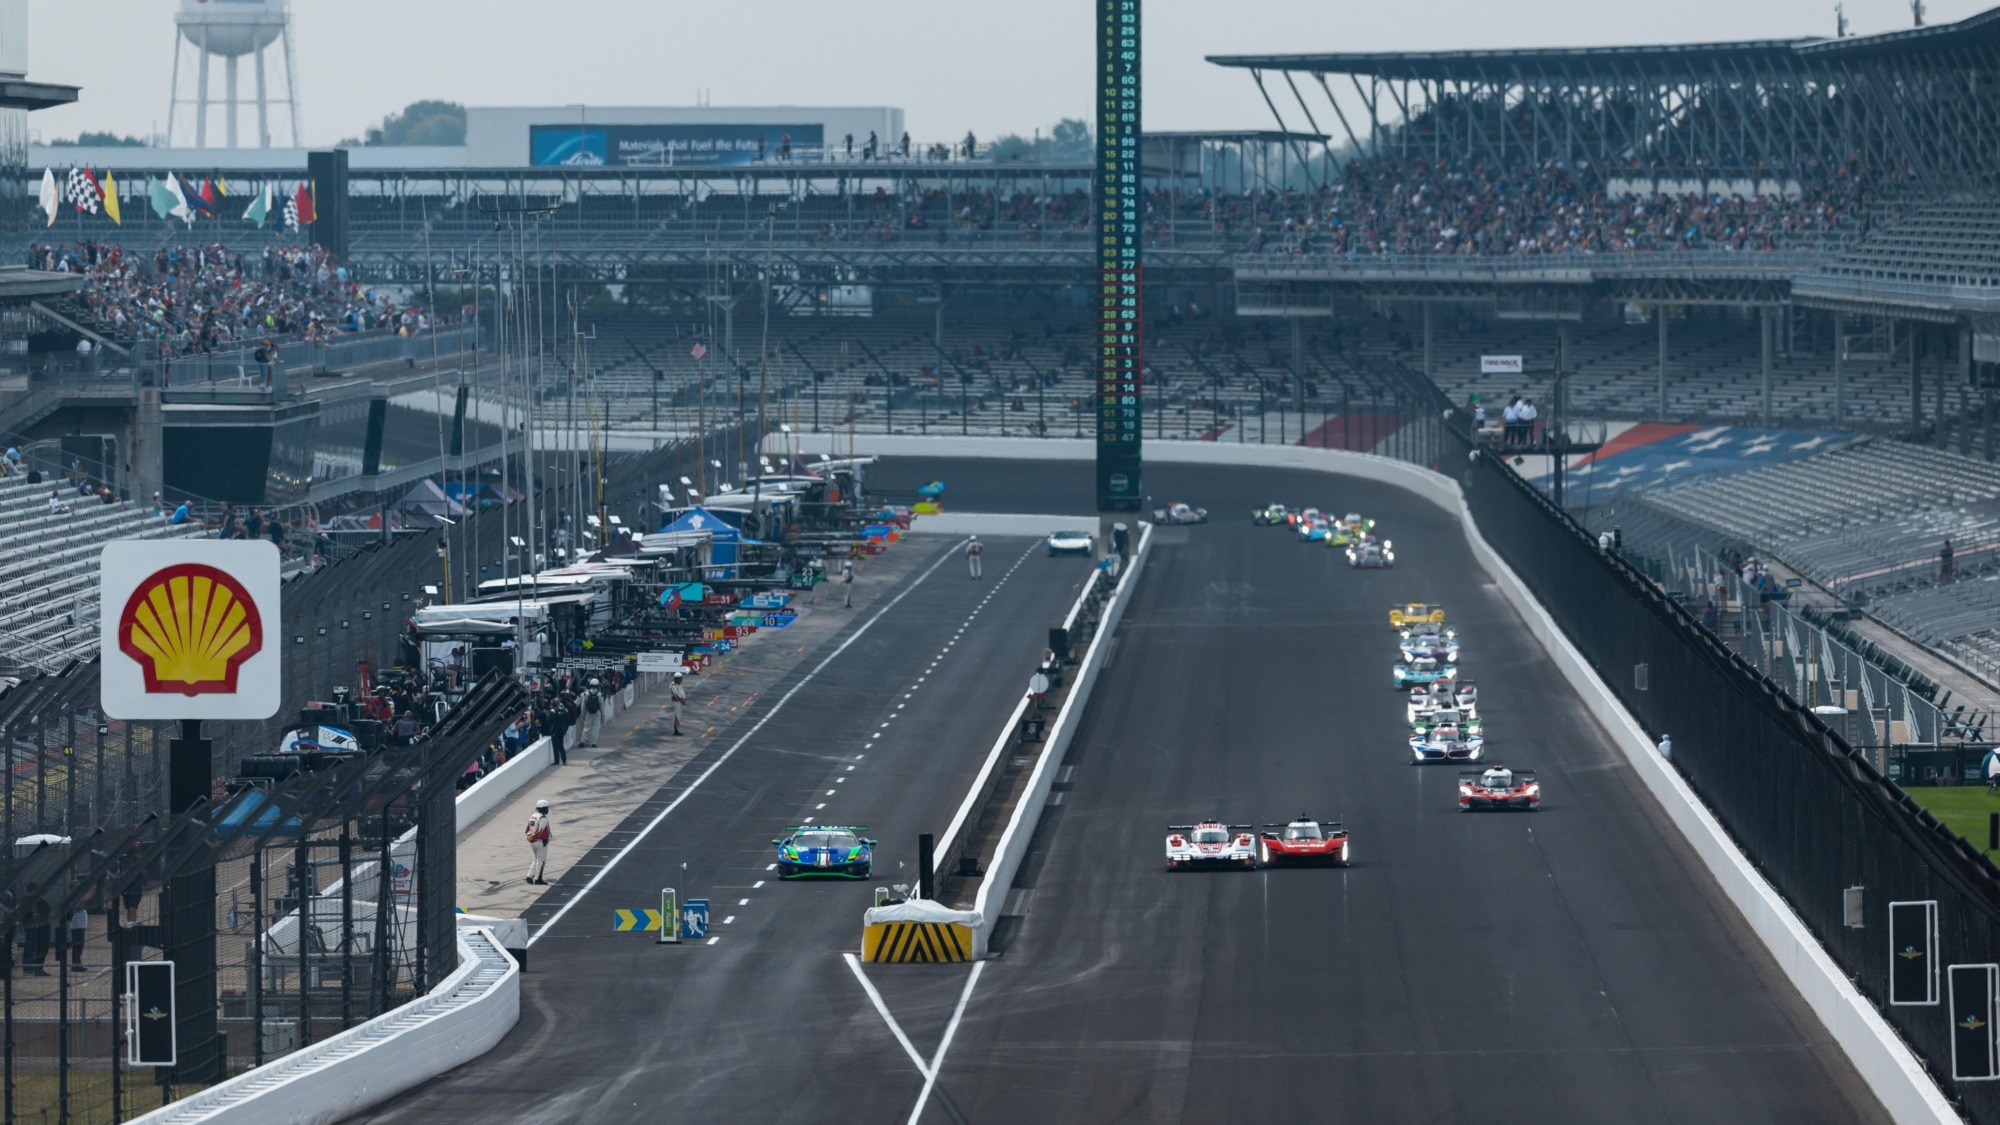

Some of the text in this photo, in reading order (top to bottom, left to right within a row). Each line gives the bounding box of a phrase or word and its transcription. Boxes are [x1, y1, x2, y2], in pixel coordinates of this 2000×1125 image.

[1107, 1, 1134, 10] 3 31
[1122, 27, 1135, 35] 25
[1122, 39, 1135, 47] 63
[1107, 51, 1135, 60] 7 40
[1125, 63, 1131, 72] 7
[1107, 76, 1135, 84] 9 60
[1105, 88, 1135, 97] 10 24
[1122, 101, 1135, 109] 23
[1105, 125, 1131, 134] 13 2
[1122, 137, 1135, 146] 99
[1105, 150, 1135, 158] 15 22
[1123, 162, 1133, 170] 11
[1105, 174, 1115, 182] 17
[1122, 187, 1135, 195] 43
[1123, 199, 1135, 207] 74
[1104, 224, 1135, 232] 21 73
[1104, 249, 1135, 257] 23 52
[1122, 261, 1135, 269] 77
[1122, 273, 1135, 281] 64
[1104, 298, 1135, 306] 27 48
[1122, 310, 1135, 318] 65
[1104, 335, 1134, 343] 30 81
[1104, 347, 1130, 355] 31 1
[1125, 359, 1132, 368] 3
[1104, 384, 1116, 392] 34
[802, 567, 813, 576] 23
[721, 595, 730, 604] 31
[753, 596, 783, 606] 64
[764, 617, 775, 626] 10
[735, 626, 749, 636] 93
[673, 656, 679, 664] 6
[702, 656, 709, 666] 4
[338, 694, 344, 703] 7
